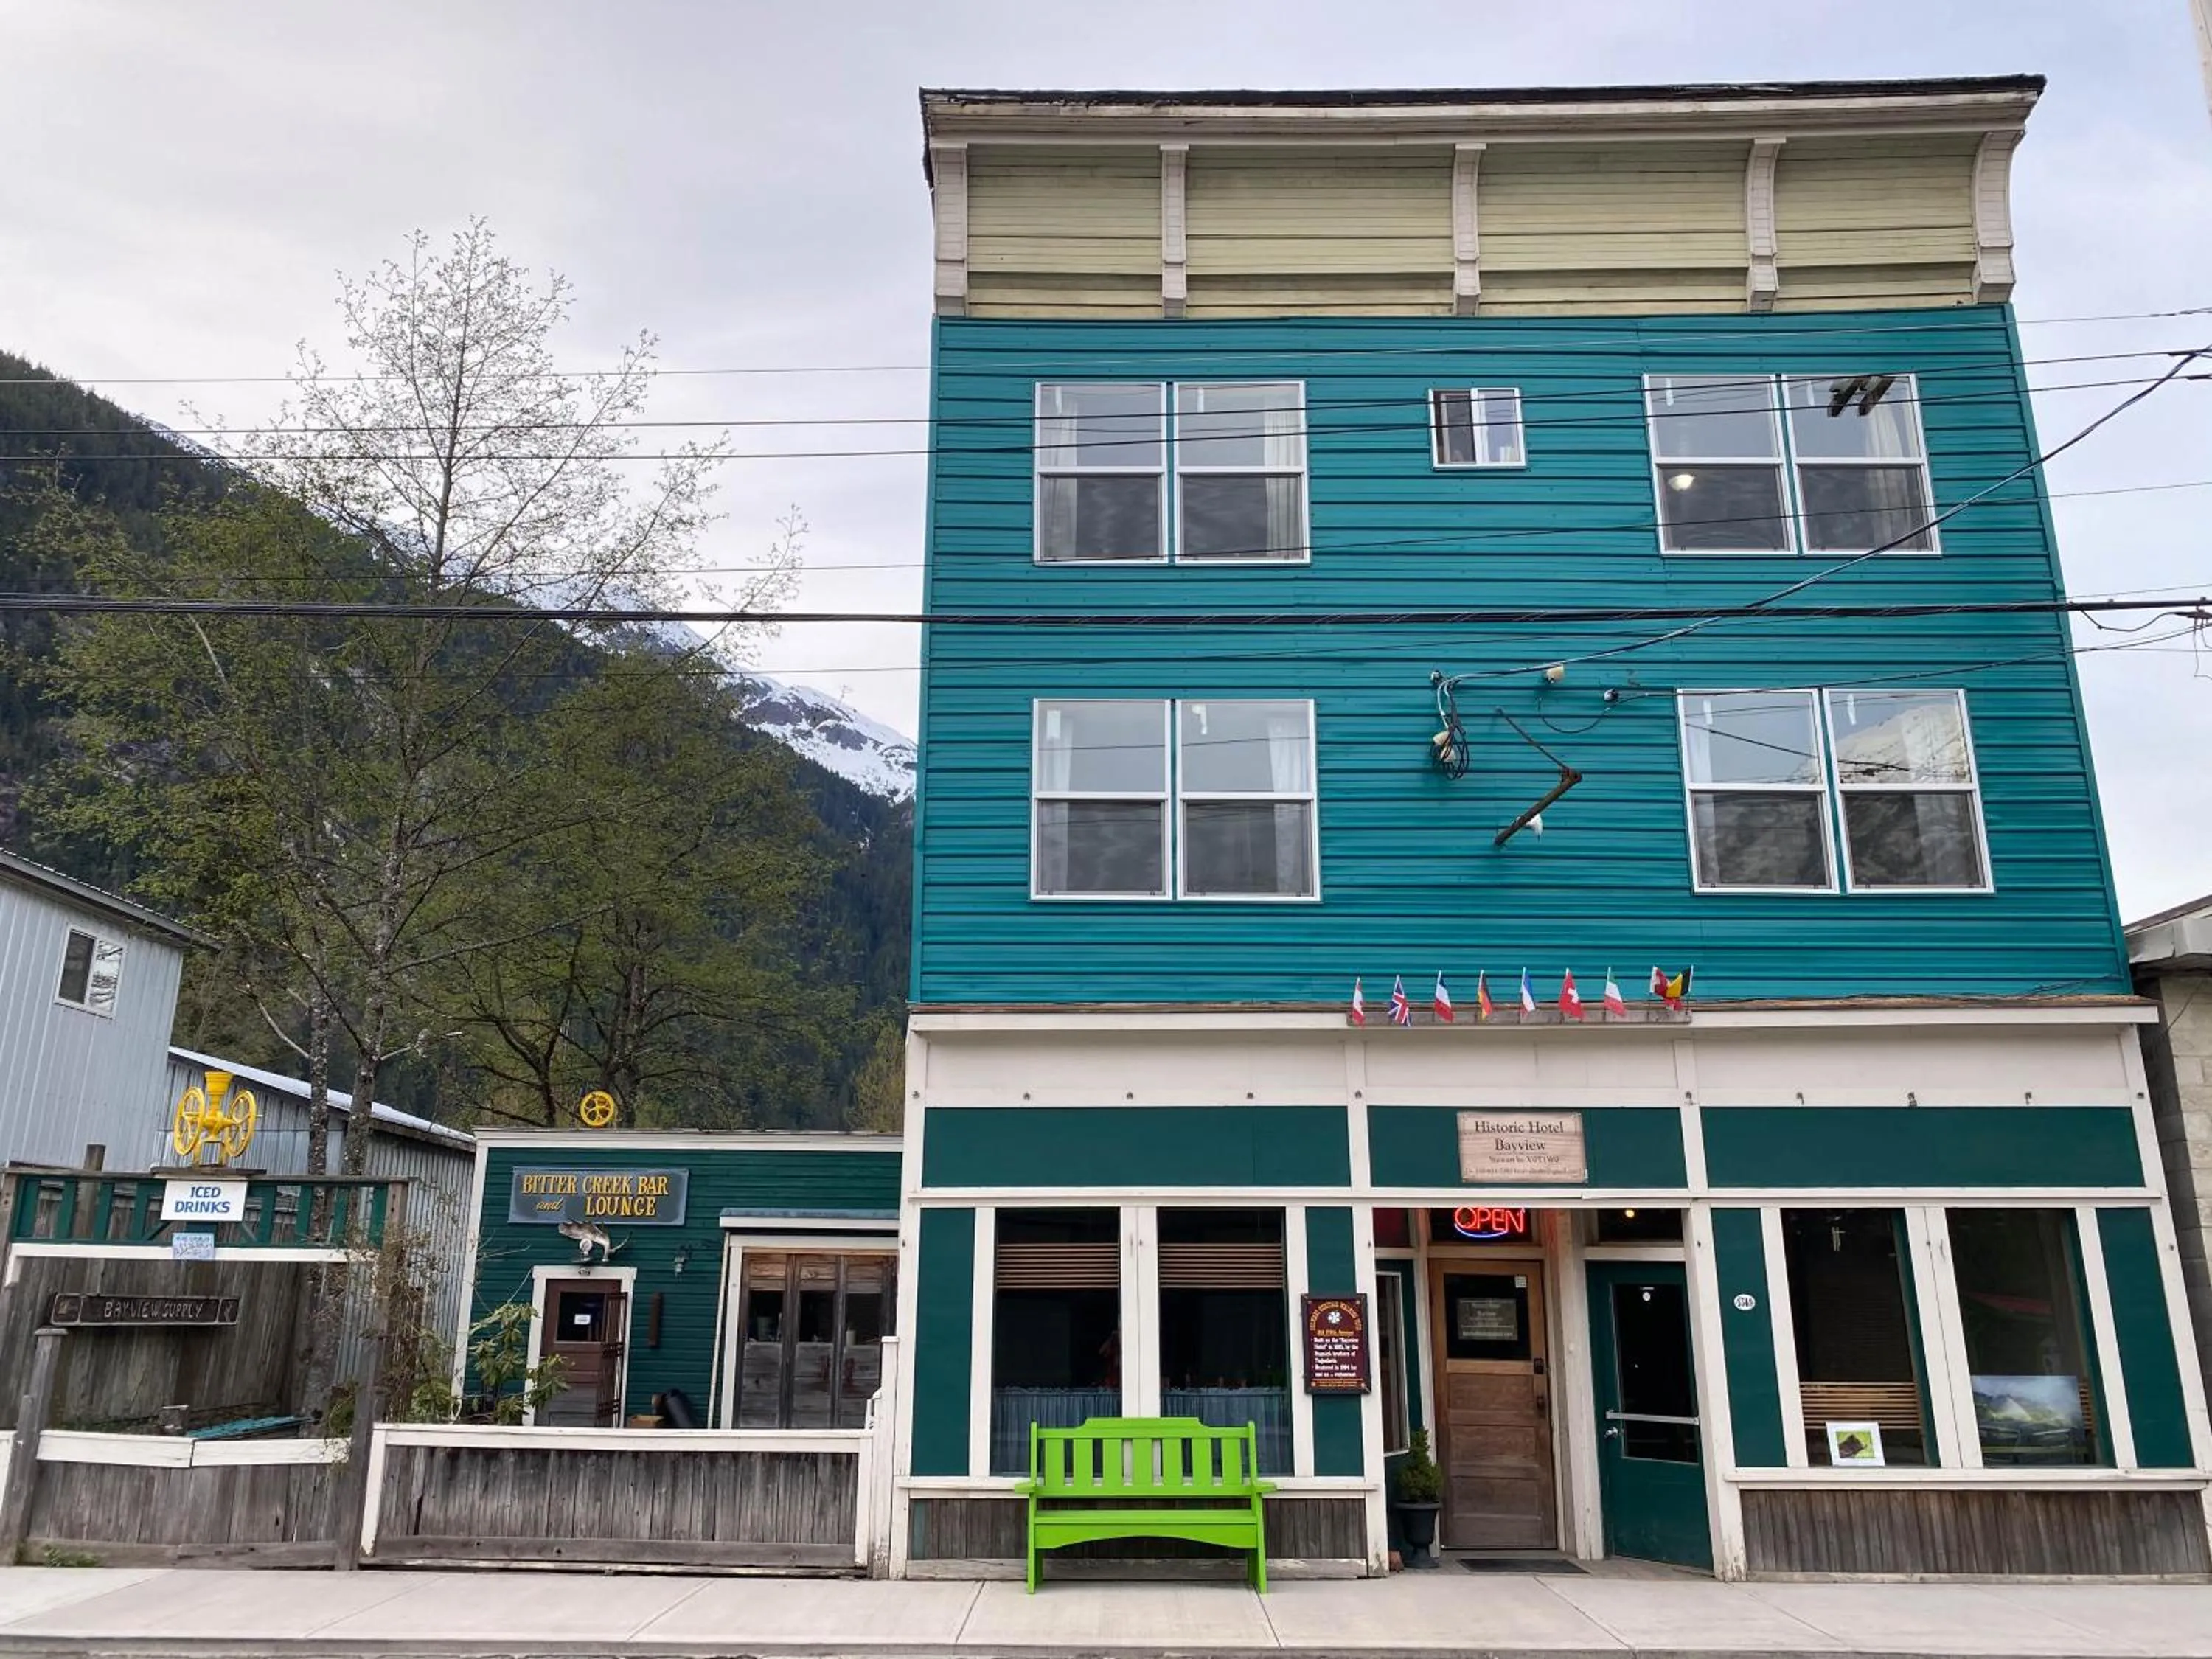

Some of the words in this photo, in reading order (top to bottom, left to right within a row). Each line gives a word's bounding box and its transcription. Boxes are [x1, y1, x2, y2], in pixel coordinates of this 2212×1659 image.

[1475, 1121, 1525, 1133] Historic
[1528, 1121, 1564, 1133] Hotel
[1495, 1138, 1546, 1154] Bayview
[190, 1186, 221, 1198] ICED
[522, 1174, 578, 1194] BITTER
[582, 1175, 632, 1195] CREEK
[636, 1176, 669, 1195] BAR
[174, 1201, 231, 1214] DRINKS
[535, 1197, 564, 1211] and
[585, 1197, 657, 1216] LOUNGE
[1455, 1206, 1526, 1233] OPEN
[104, 1301, 159, 1318] BAYVIEW
[161, 1302, 204, 1319] SUPPLY
